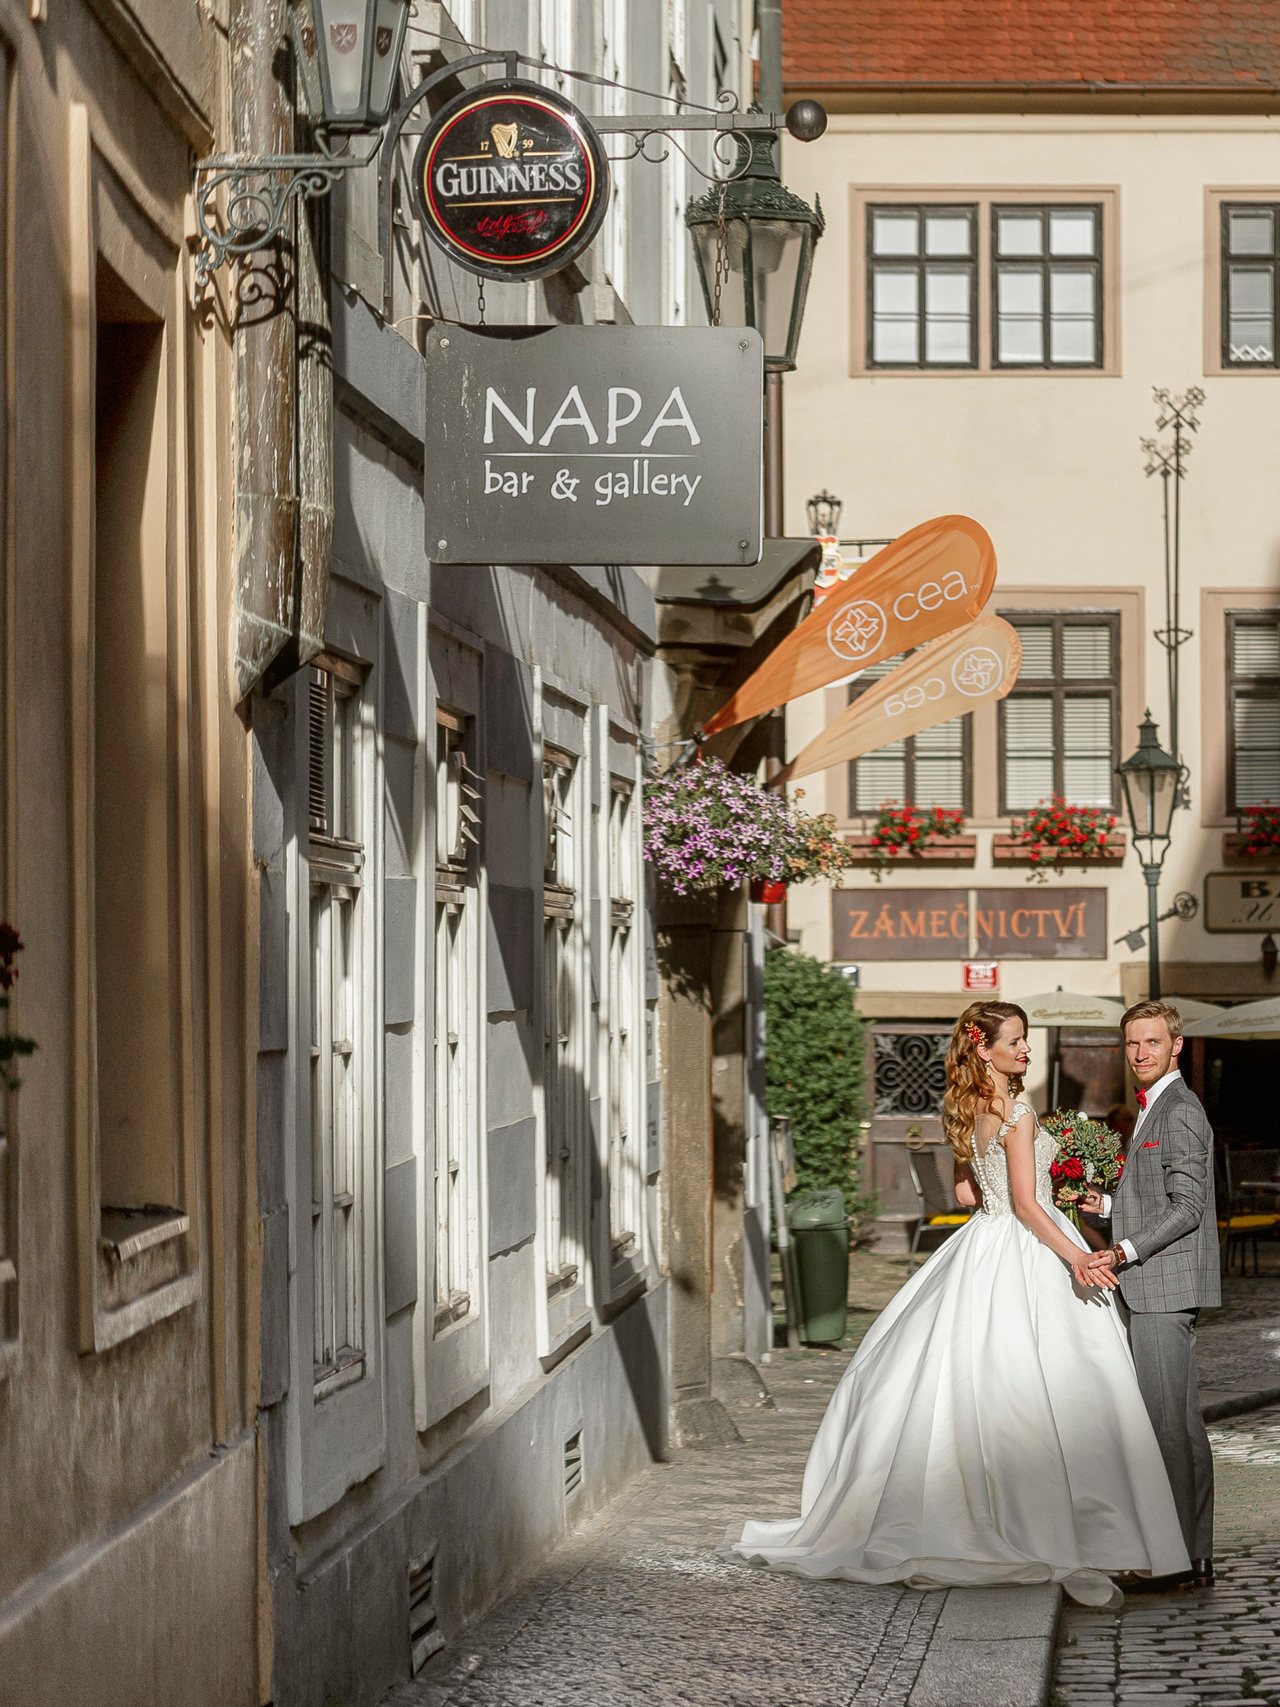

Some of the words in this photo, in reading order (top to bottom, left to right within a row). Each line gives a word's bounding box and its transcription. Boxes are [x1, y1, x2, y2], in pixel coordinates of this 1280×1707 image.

[480, 141, 490, 151] 17
[522, 139, 534, 149] 59
[436, 163, 581, 197] GUINNESS
[483, 385, 701, 447] NAPA
[484, 459, 535, 495] bar
[550, 468, 578, 502] &
[595, 459, 702, 506] gallery
[893, 570, 968, 621] cea
[849, 902, 1088, 939] ZÁMEČNICTVÍ
